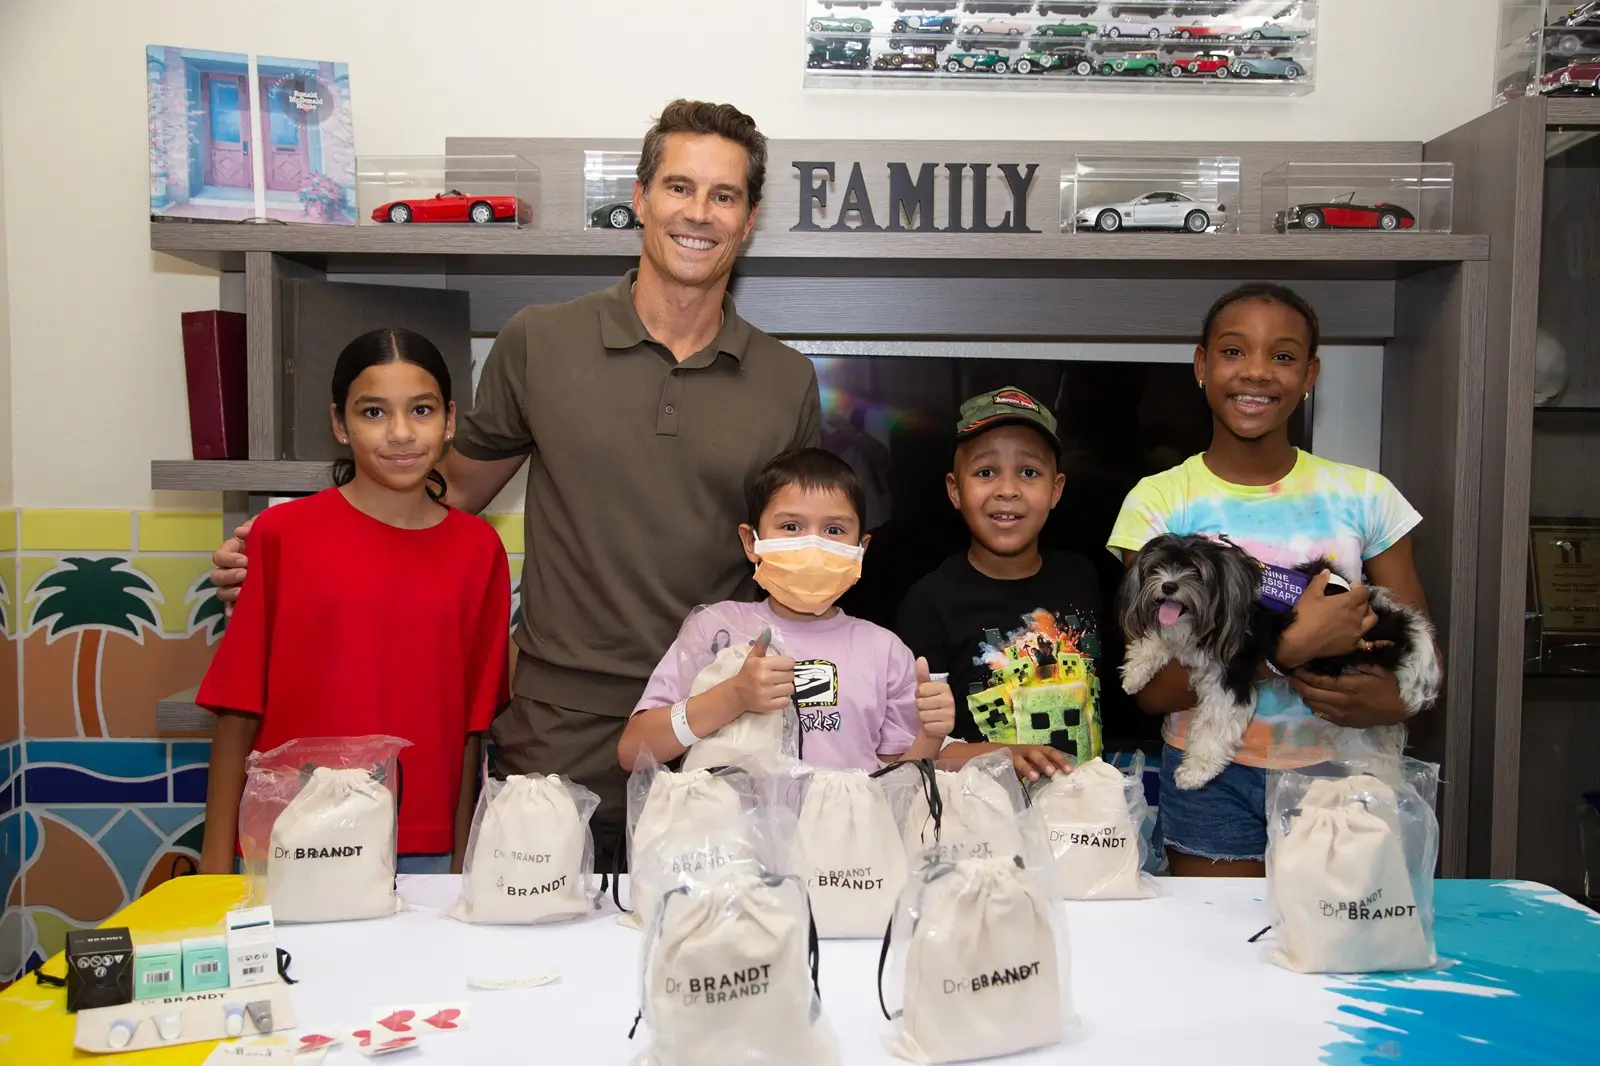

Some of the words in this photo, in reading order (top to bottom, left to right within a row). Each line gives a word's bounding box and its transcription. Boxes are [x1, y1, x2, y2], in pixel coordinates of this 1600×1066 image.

[289, 96, 323, 105] McDonald
[789, 161, 1042, 233] FAMILY
[1262, 569, 1290, 582] NINE
[1261, 575, 1303, 595] SSISTED
[1261, 584, 1298, 603] HERAPY
[1070, 833, 1126, 848] BRANDT
[274, 847, 291, 859] Dr.
[296, 846, 363, 859] BRANDT
[507, 875, 567, 896] BRANDT
[818, 875, 883, 890] BRANDT
[1348, 906, 1416, 920] BRANDT
[665, 977, 685, 994] Dr.
[690, 964, 771, 993] BRANDT
[163, 993, 226, 1004] BRANDT
[706, 982, 769, 1004] BRANDT
